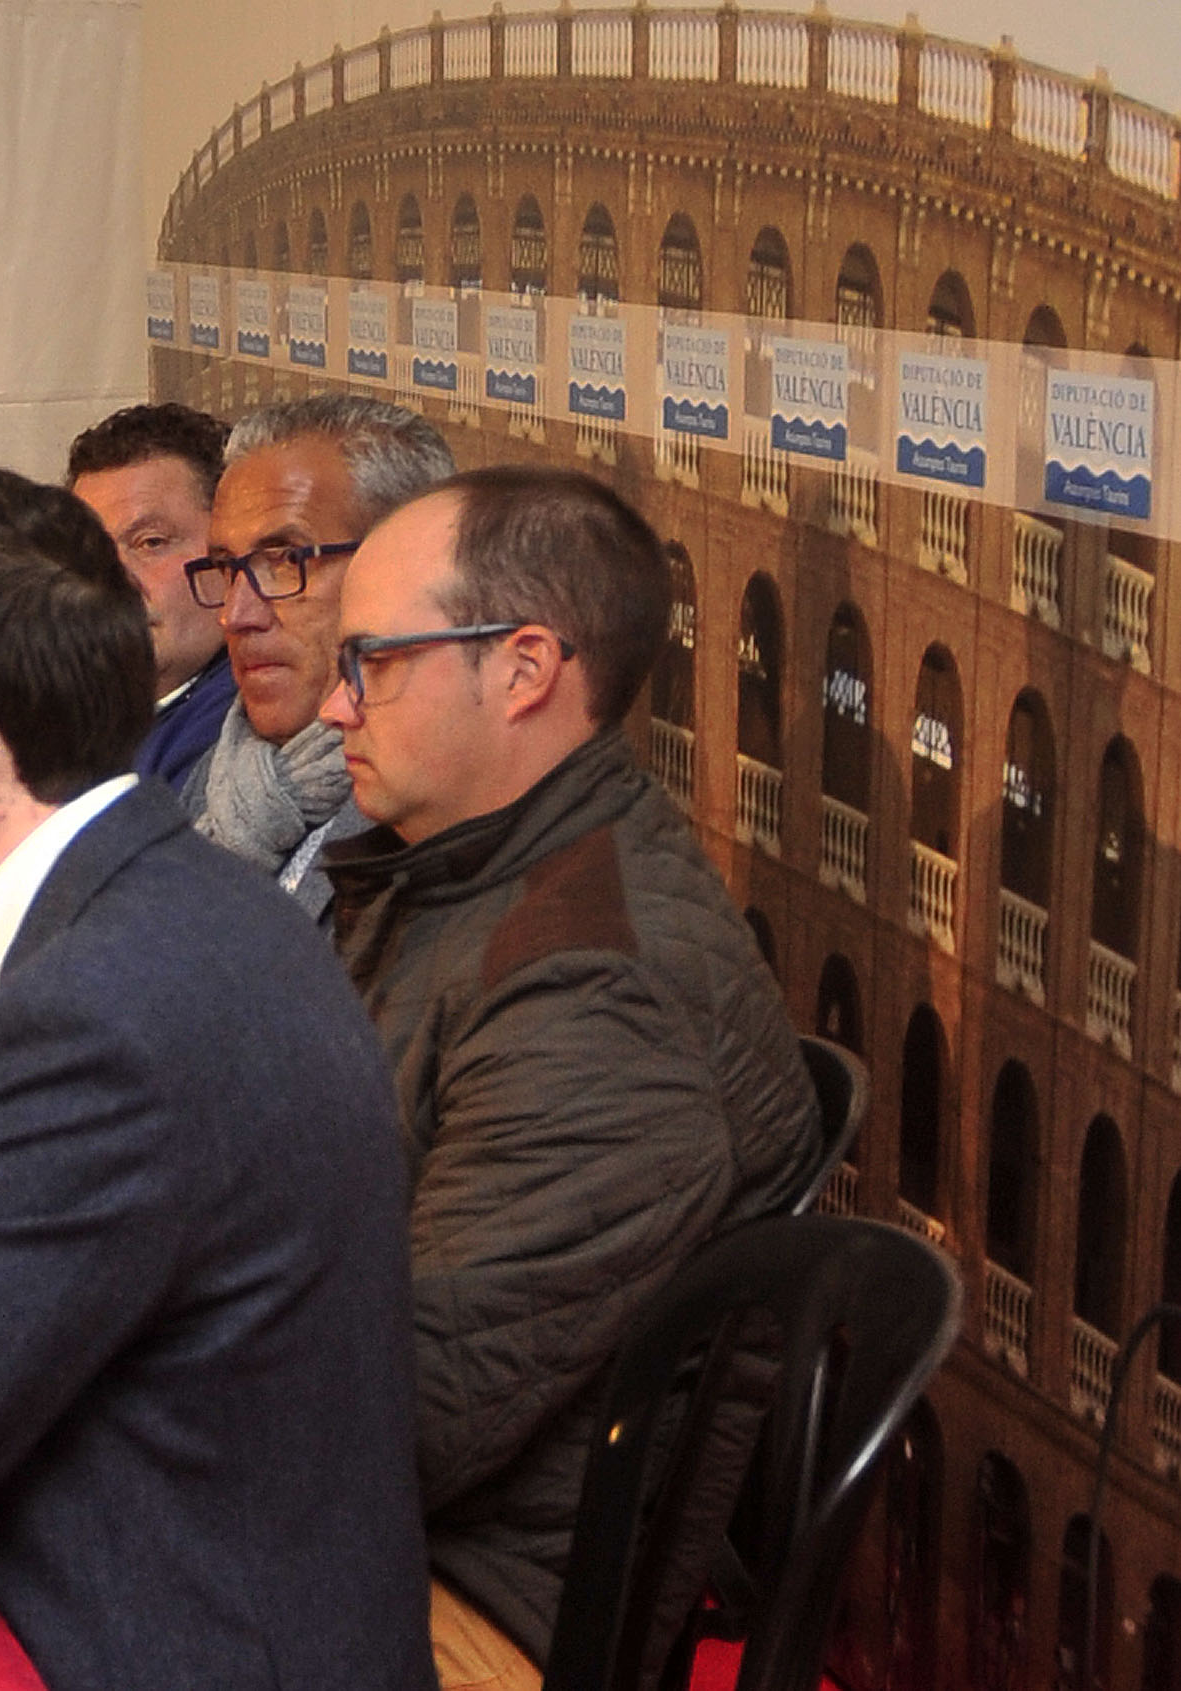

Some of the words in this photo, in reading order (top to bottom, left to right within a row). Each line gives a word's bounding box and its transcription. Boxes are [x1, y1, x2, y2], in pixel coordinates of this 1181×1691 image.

[967, 371, 982, 390] DE
[902, 390, 983, 433] VALÈNCIA
[1128, 391, 1148, 412] DE
[1051, 411, 1146, 459] VALÈNCIA
